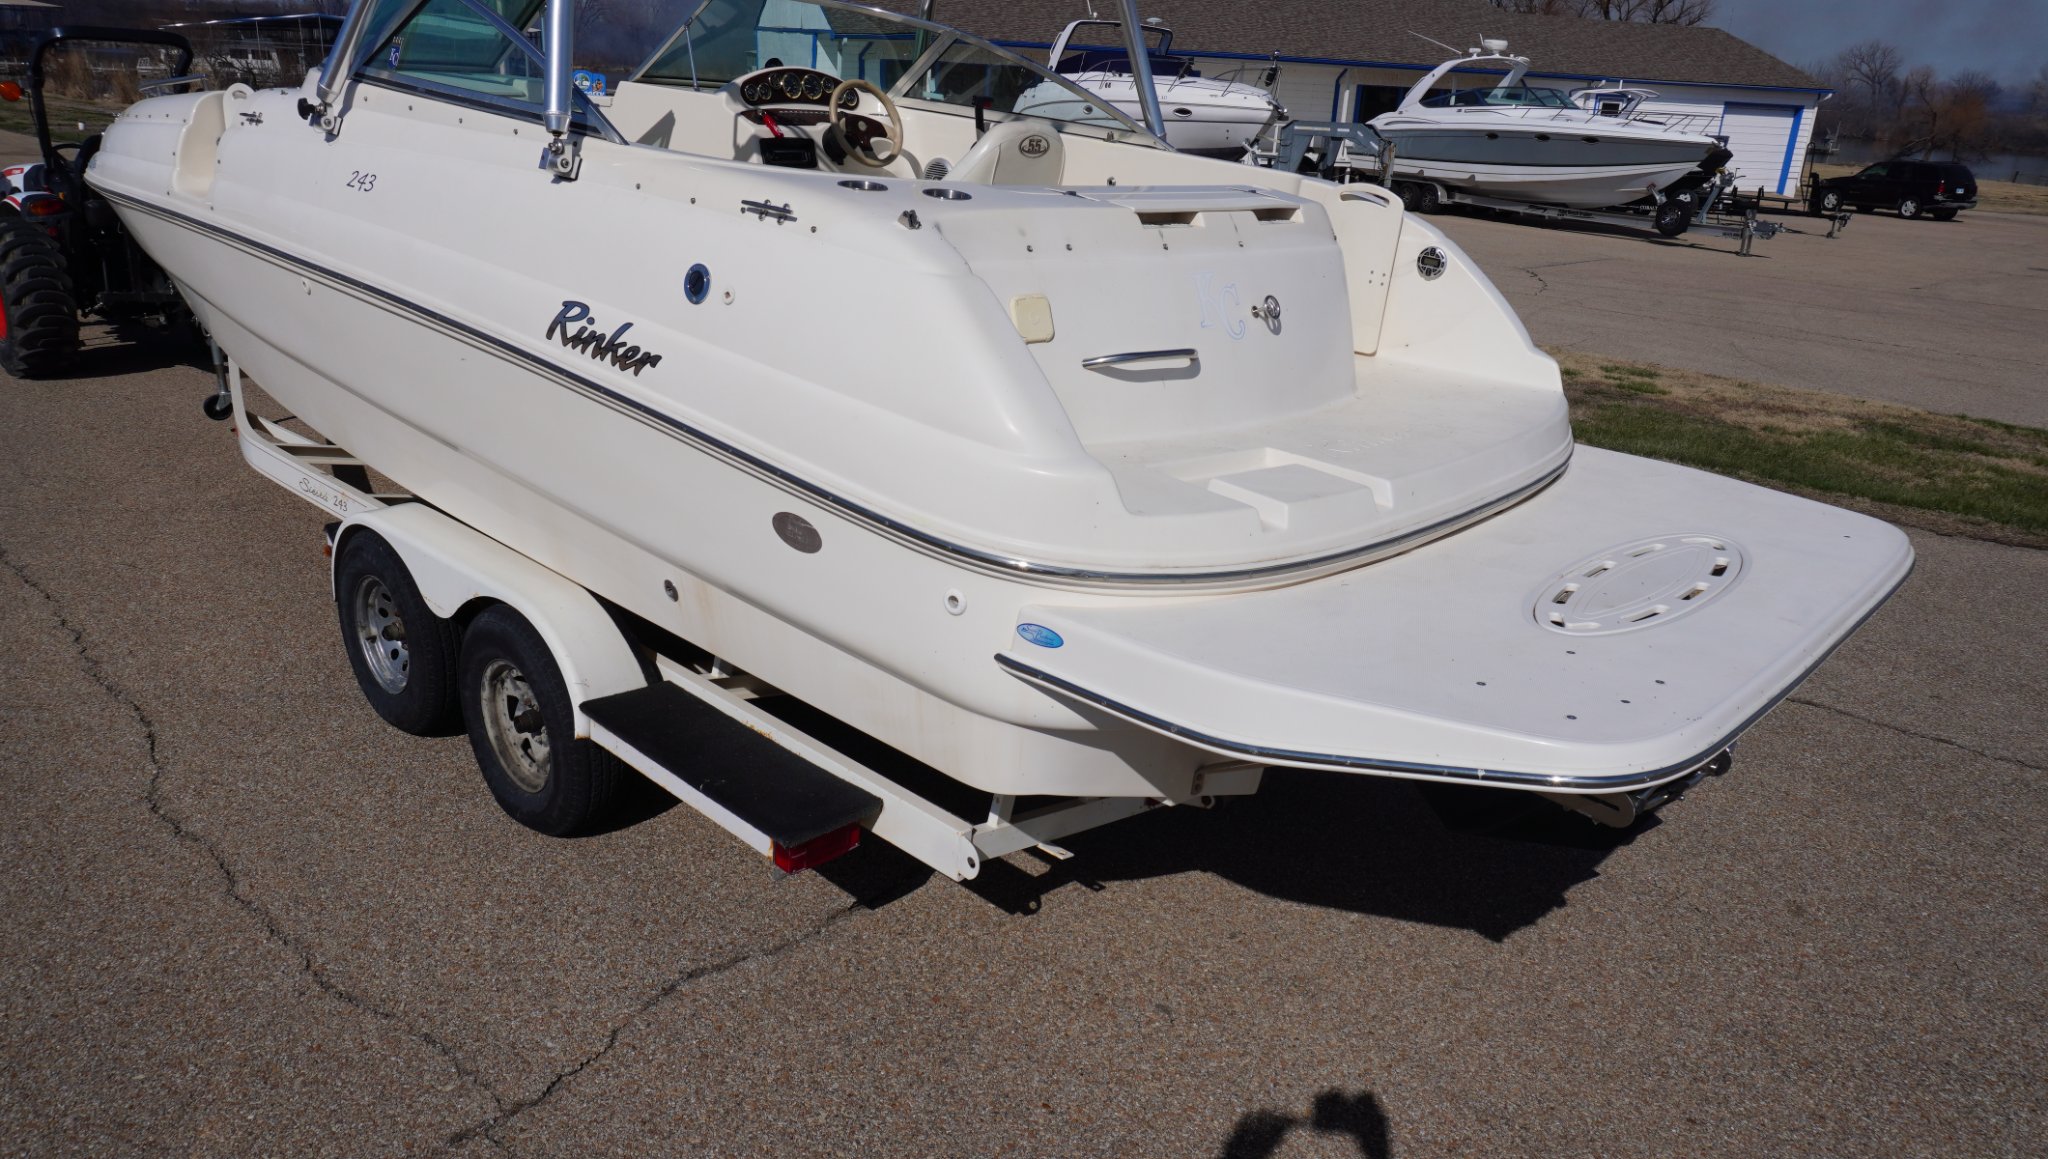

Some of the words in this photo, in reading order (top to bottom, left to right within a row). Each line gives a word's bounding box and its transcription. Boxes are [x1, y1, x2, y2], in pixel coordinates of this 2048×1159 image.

[346, 170, 377, 192] 243
[545, 300, 662, 377] Rinker
[333, 495, 348, 512] 243
